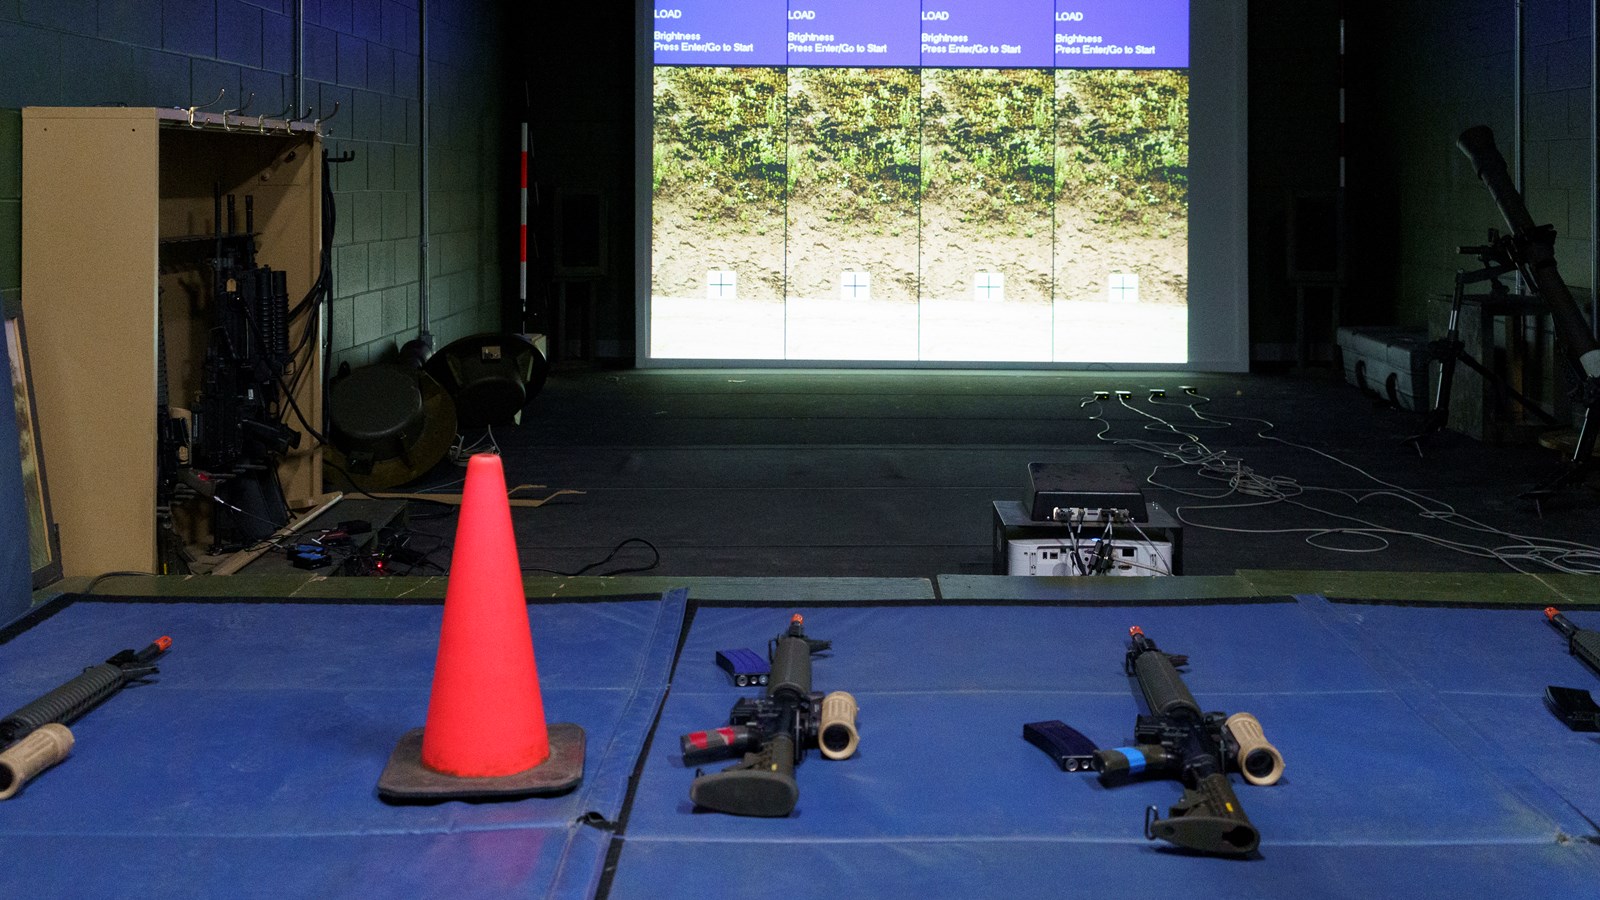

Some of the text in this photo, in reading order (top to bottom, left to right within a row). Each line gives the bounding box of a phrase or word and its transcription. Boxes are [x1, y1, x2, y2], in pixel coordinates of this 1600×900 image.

[654, 9, 682, 19] LOAD
[788, 10, 816, 20] LOAD
[922, 11, 950, 21] LOAD
[1056, 12, 1084, 22] LOAD
[654, 31, 701, 42] Brightness
[788, 32, 835, 43] Brightness
[922, 33, 969, 44] Brightness
[1056, 34, 1103, 45] Brightness
[654, 42, 754, 52] Press Enter/Go to Start
[788, 43, 888, 53] Press Enter/Go to Start
[922, 44, 1022, 54] Press Enter/Go to Start
[1056, 45, 1156, 55] Press Enter/Go to Start
